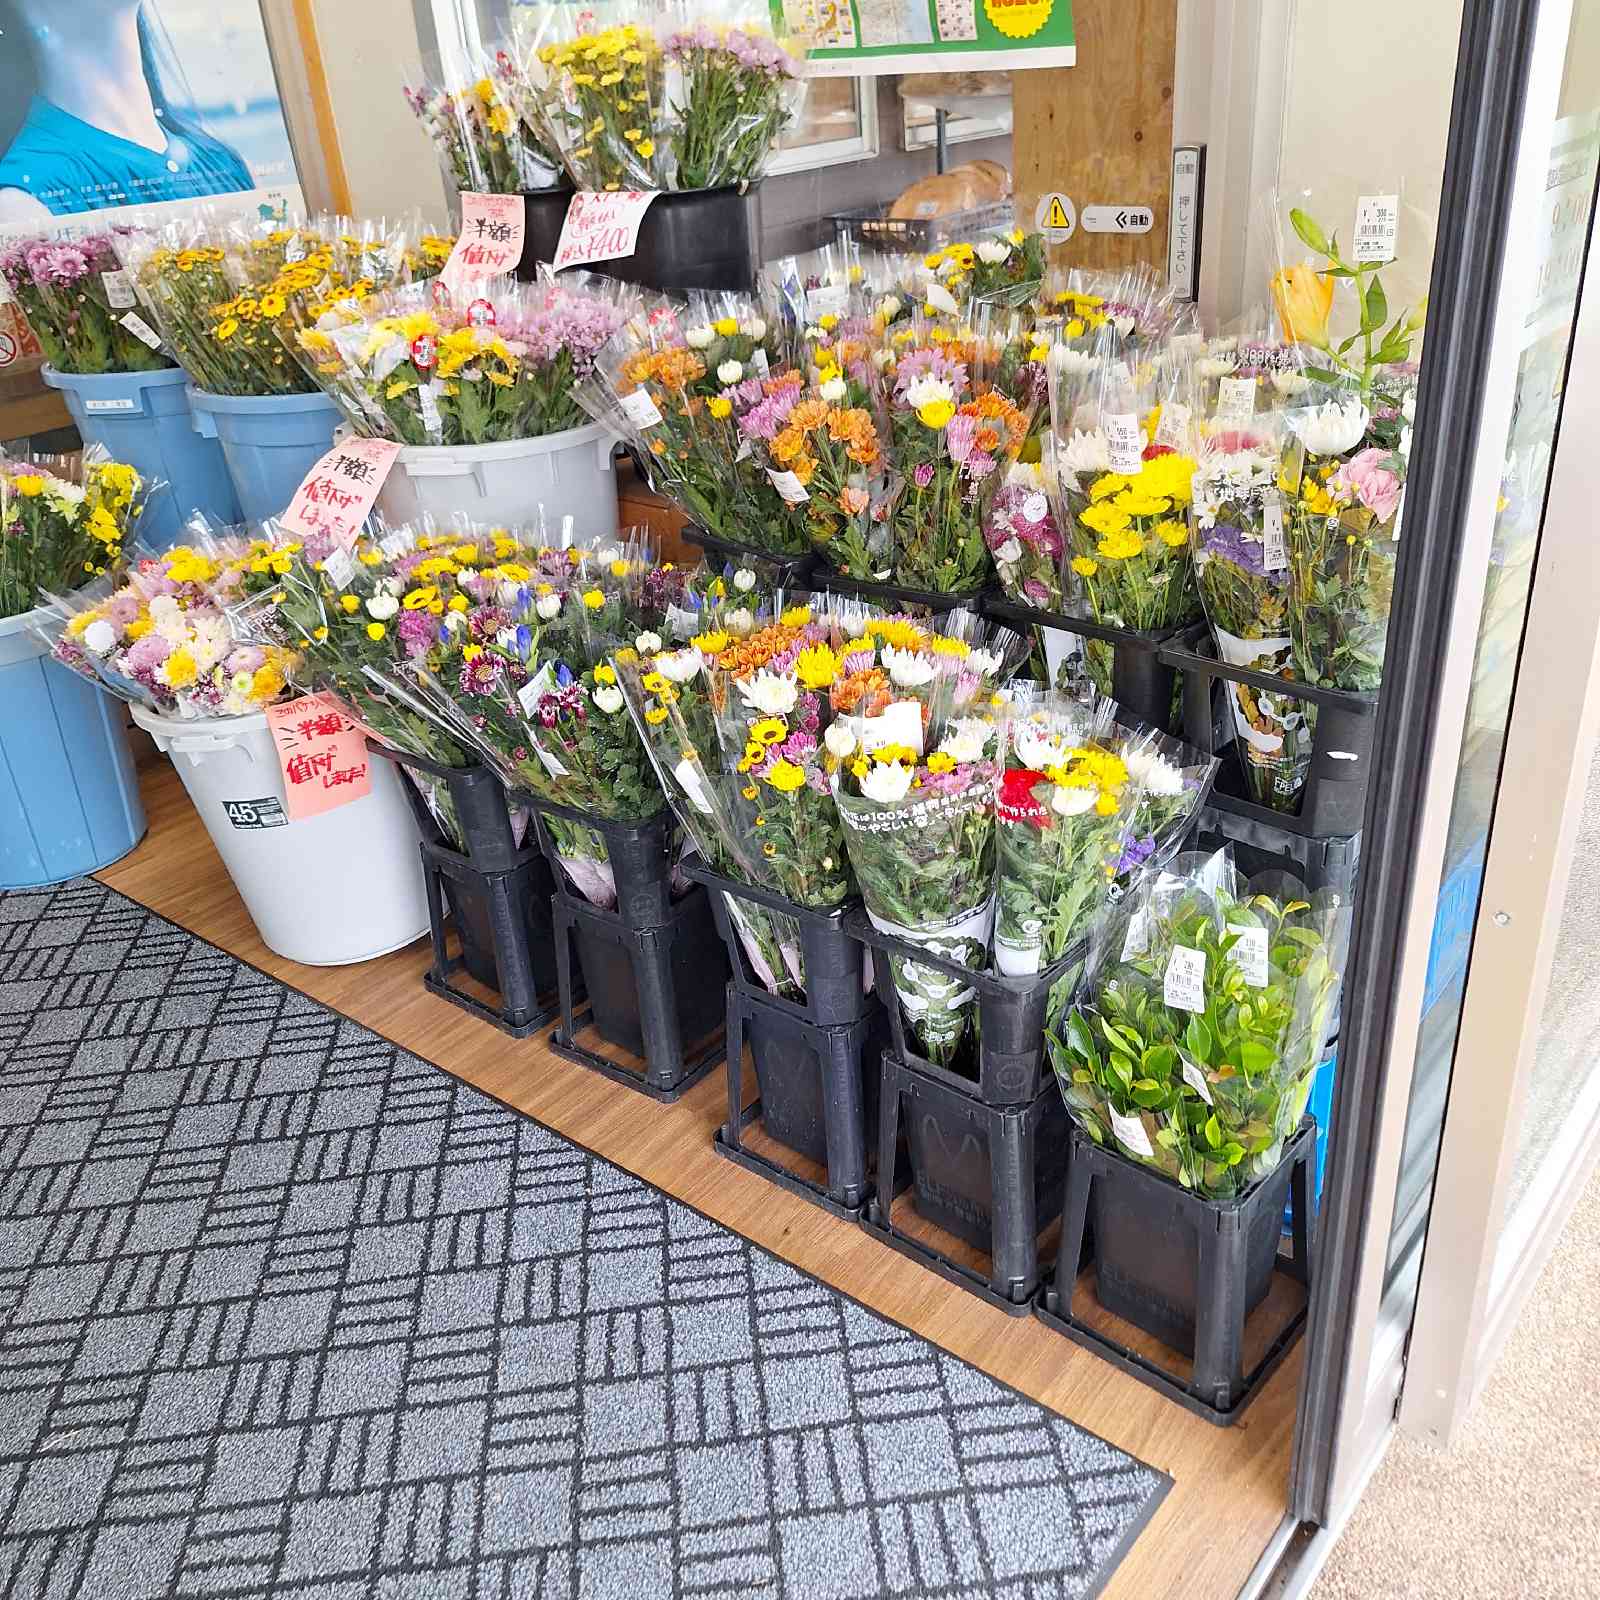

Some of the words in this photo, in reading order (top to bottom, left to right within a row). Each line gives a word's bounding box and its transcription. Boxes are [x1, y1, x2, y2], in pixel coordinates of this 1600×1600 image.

[472, 217, 512, 243] 半額
[1130, 214, 1149, 226] 自動
[334, 454, 373, 480] 半額
[297, 712, 344, 741] 半額
[286, 745, 338, 785] 値下げ
[228, 803, 258, 824] 45
